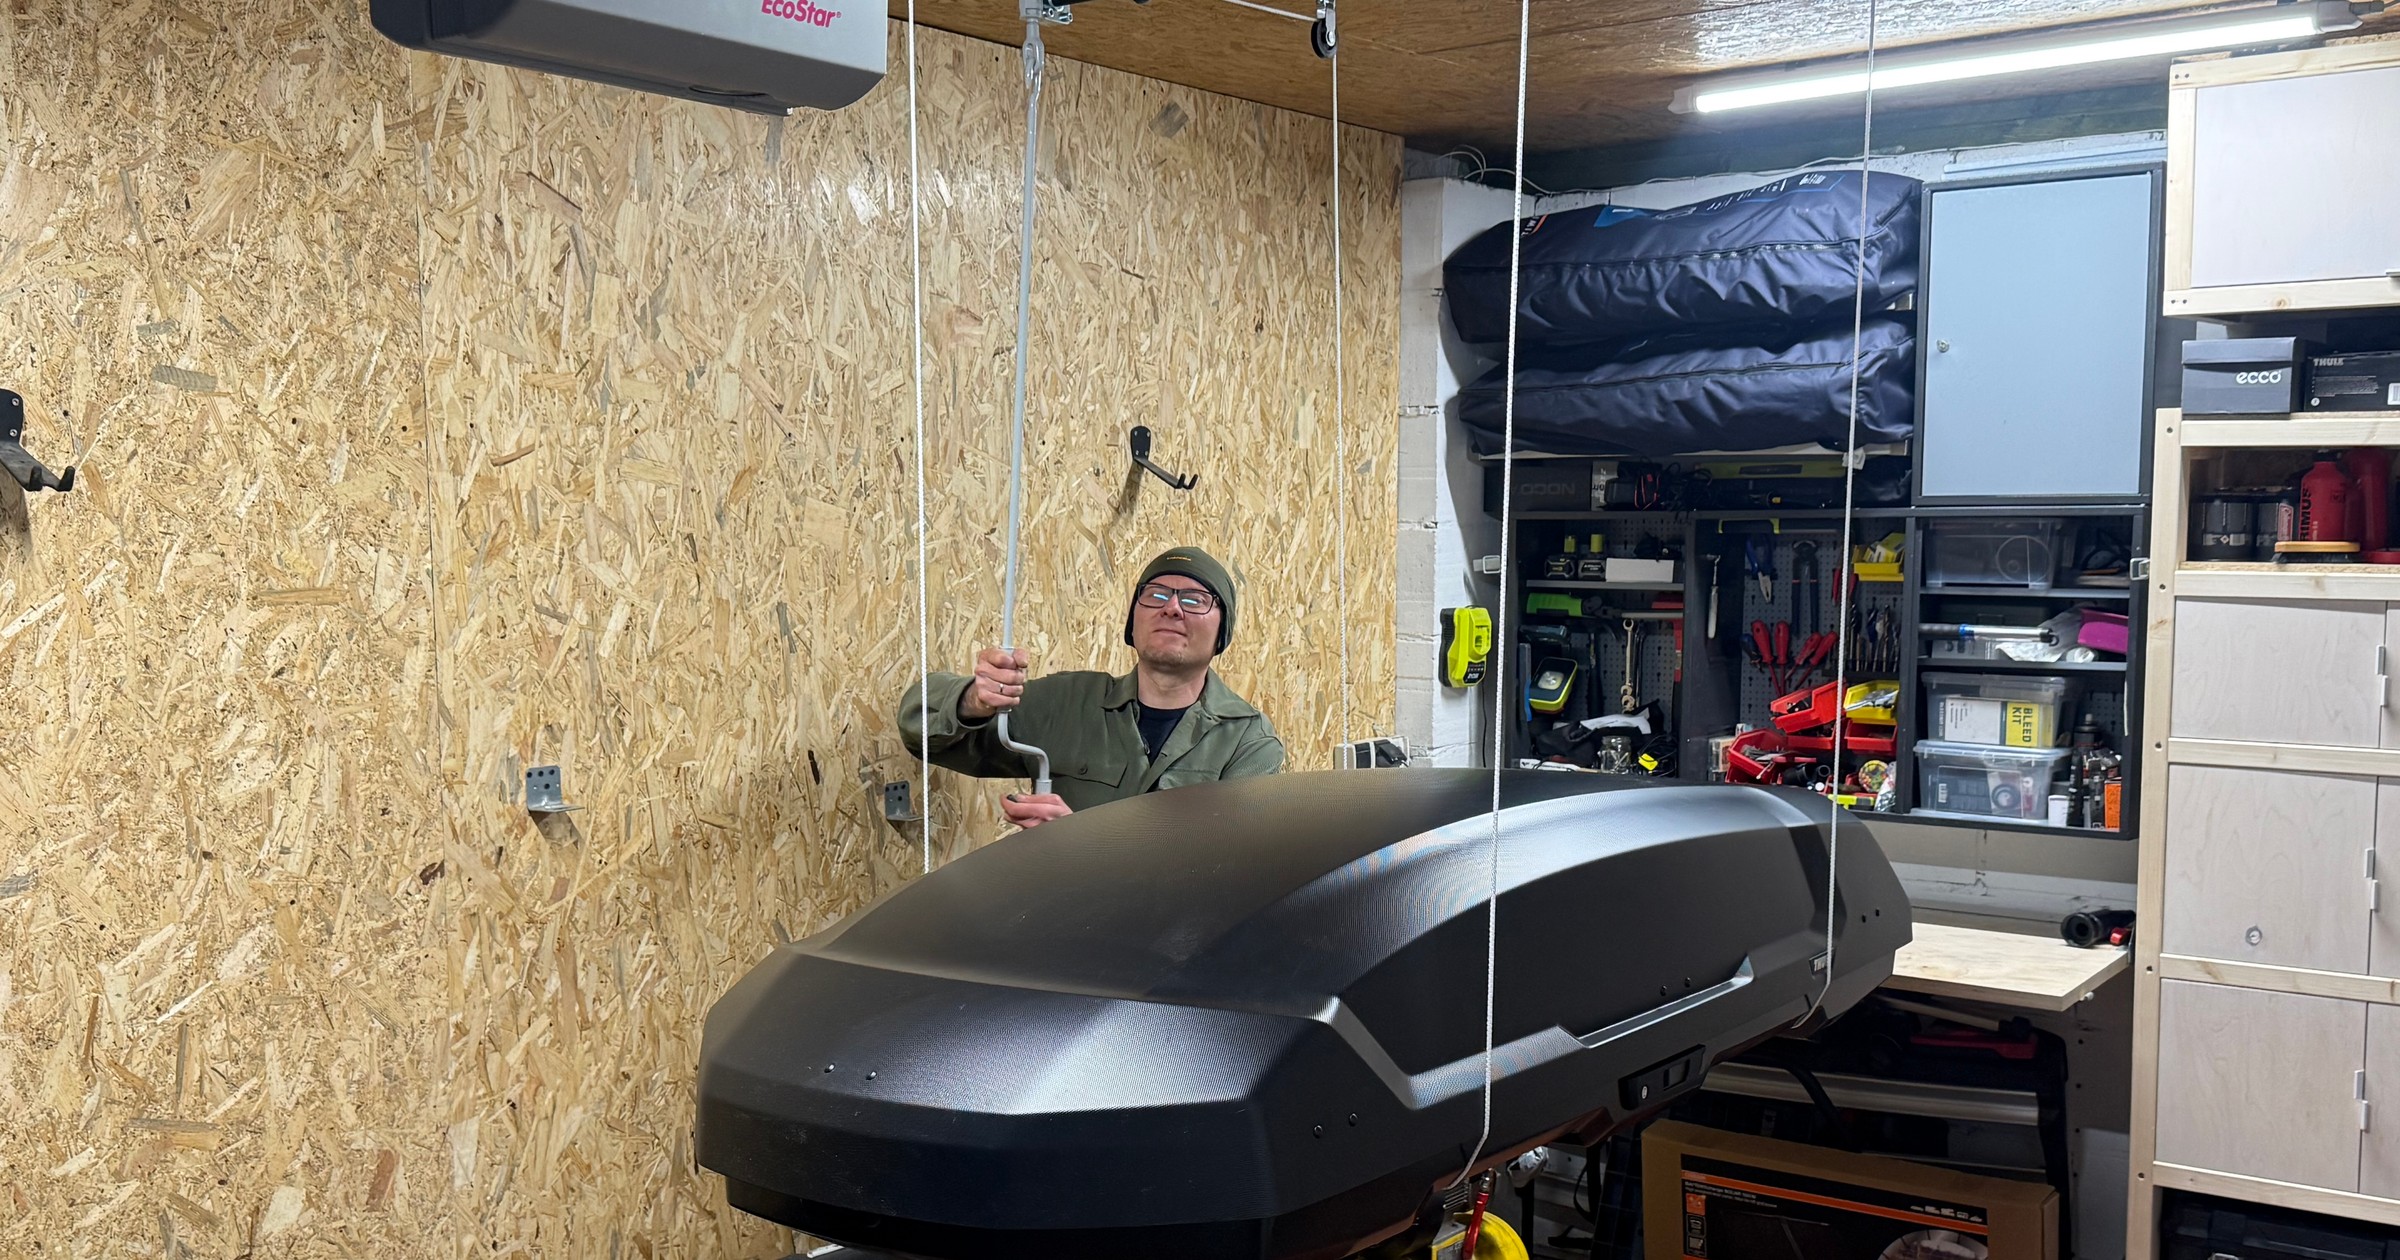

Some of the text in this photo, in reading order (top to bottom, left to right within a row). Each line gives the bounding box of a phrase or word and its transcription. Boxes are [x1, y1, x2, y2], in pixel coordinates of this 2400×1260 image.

[2313, 357, 2345, 367] THULE
[2236, 370, 2282, 384] ecco
[2300, 488, 2311, 540] RIMUS
[2012, 707, 2022, 725] KIT
[2022, 708, 2034, 742] BLEED
